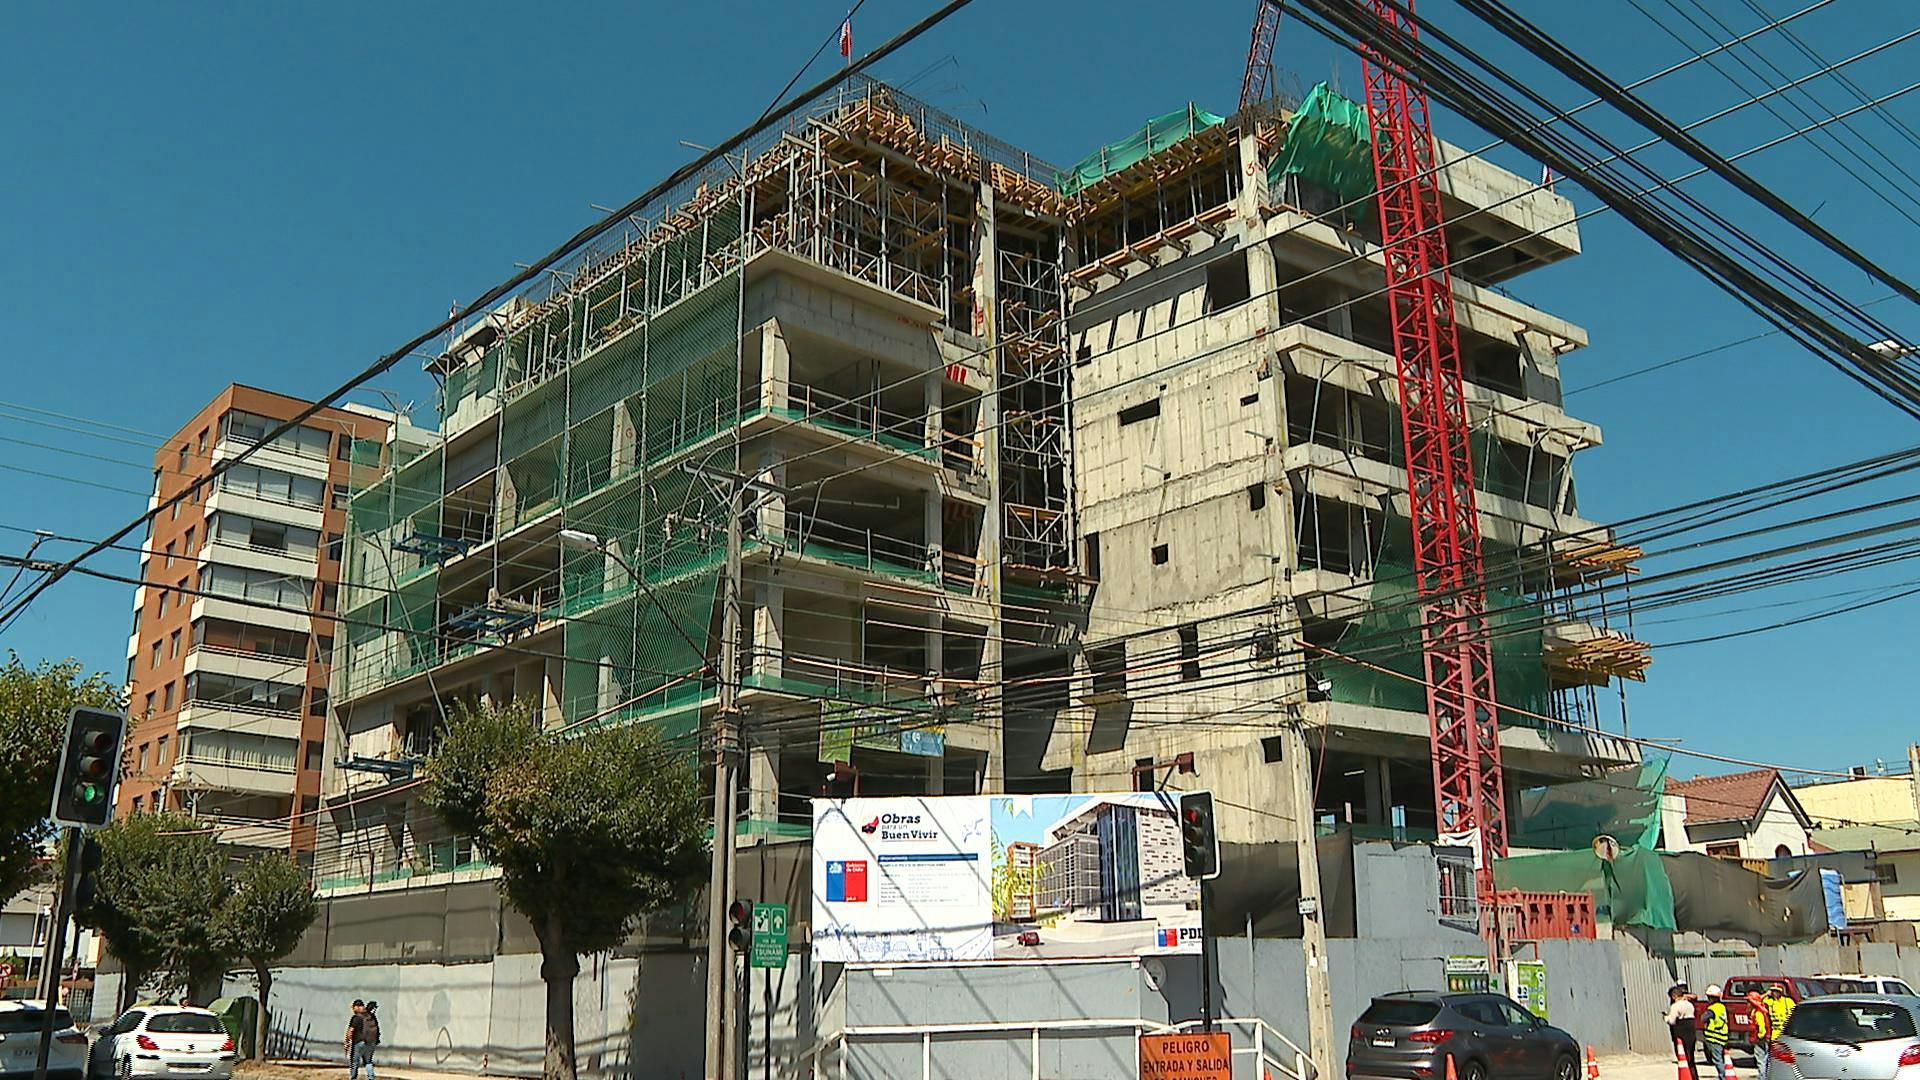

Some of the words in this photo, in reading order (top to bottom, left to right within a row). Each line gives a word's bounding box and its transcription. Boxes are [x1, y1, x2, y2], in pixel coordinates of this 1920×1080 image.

[881, 813, 921, 825] Obras
[1162, 1040, 1209, 1055] PELIGRO
[1143, 1060, 1185, 1073] ENTRADA
[1187, 1060, 1193, 1072] Y
[1196, 1058, 1229, 1072] SALIDA
